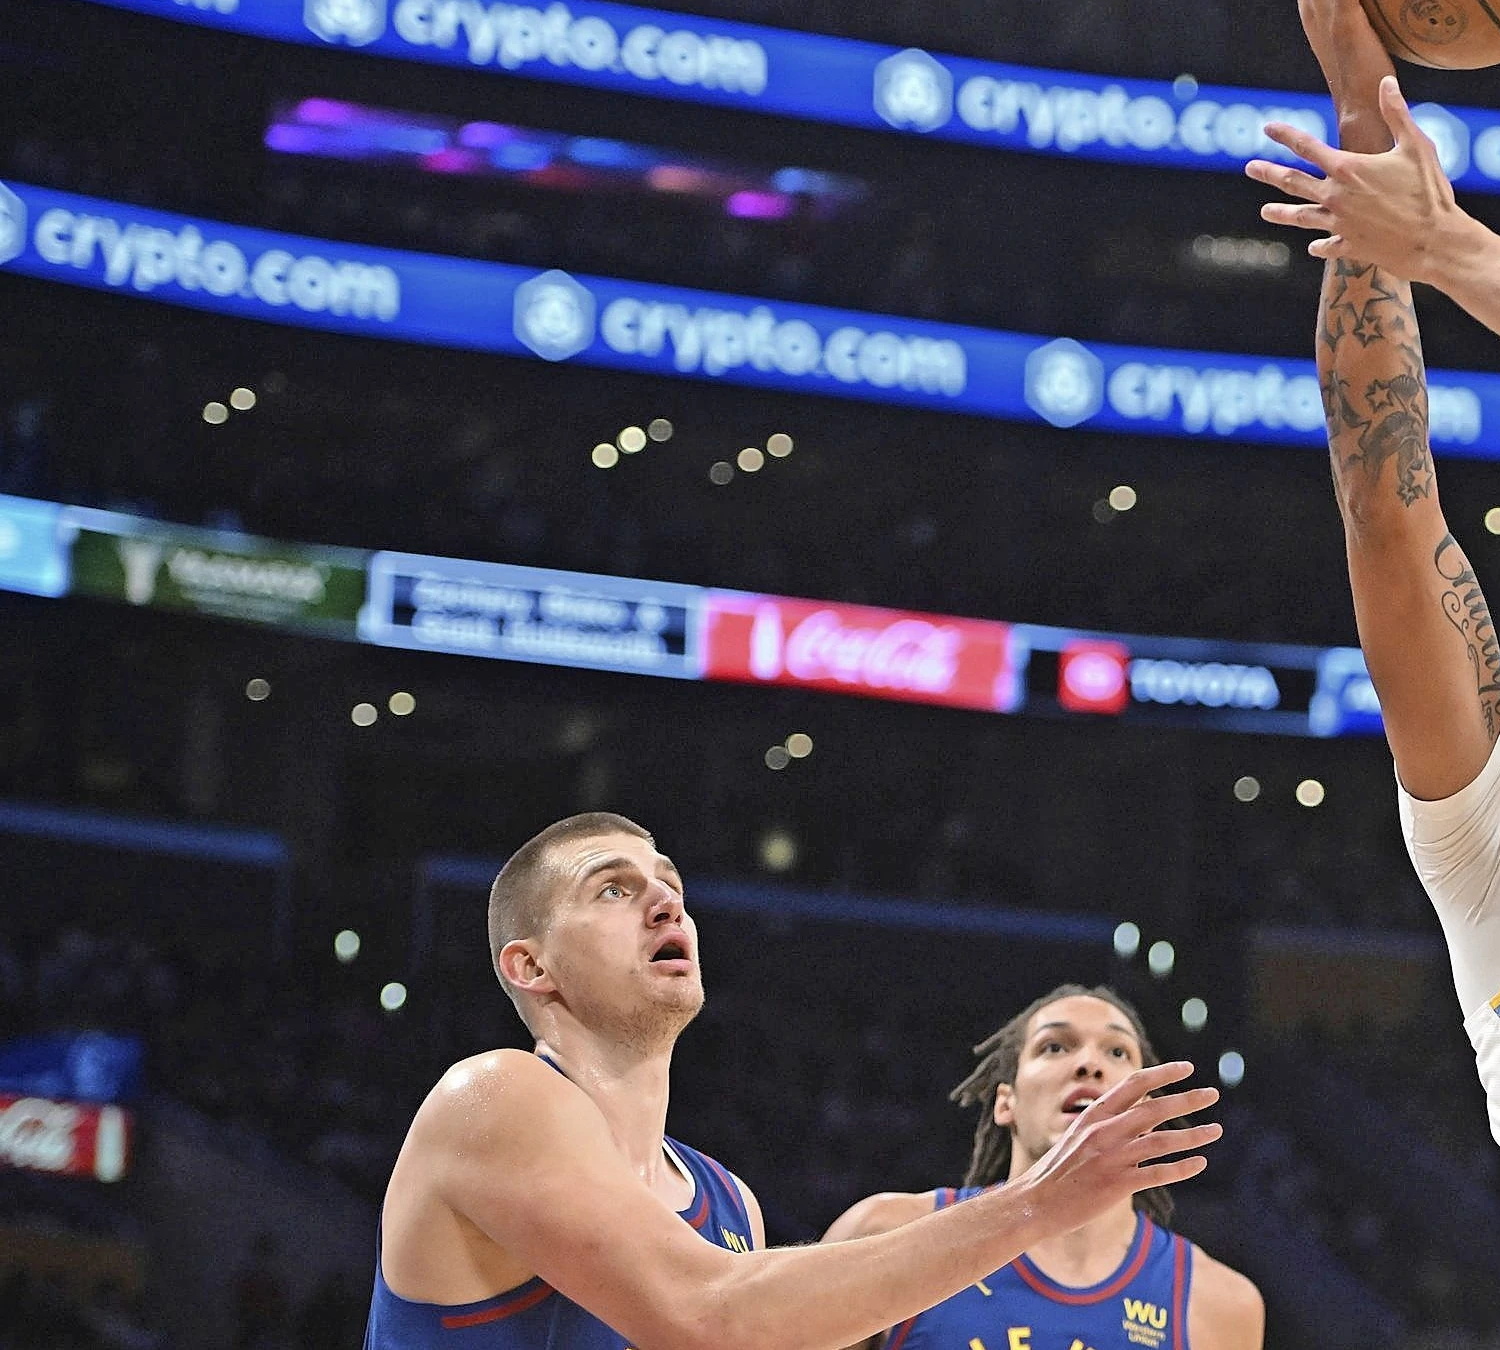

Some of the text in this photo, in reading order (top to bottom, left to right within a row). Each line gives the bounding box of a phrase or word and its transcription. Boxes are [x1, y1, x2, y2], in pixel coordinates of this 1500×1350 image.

[394, 0, 767, 96] crypto.com
[35, 206, 400, 323] crypto.com
[602, 297, 968, 397] crypto.com
[1130, 658, 1280, 711] TOYOTA
[1123, 1297, 1168, 1329] WU
